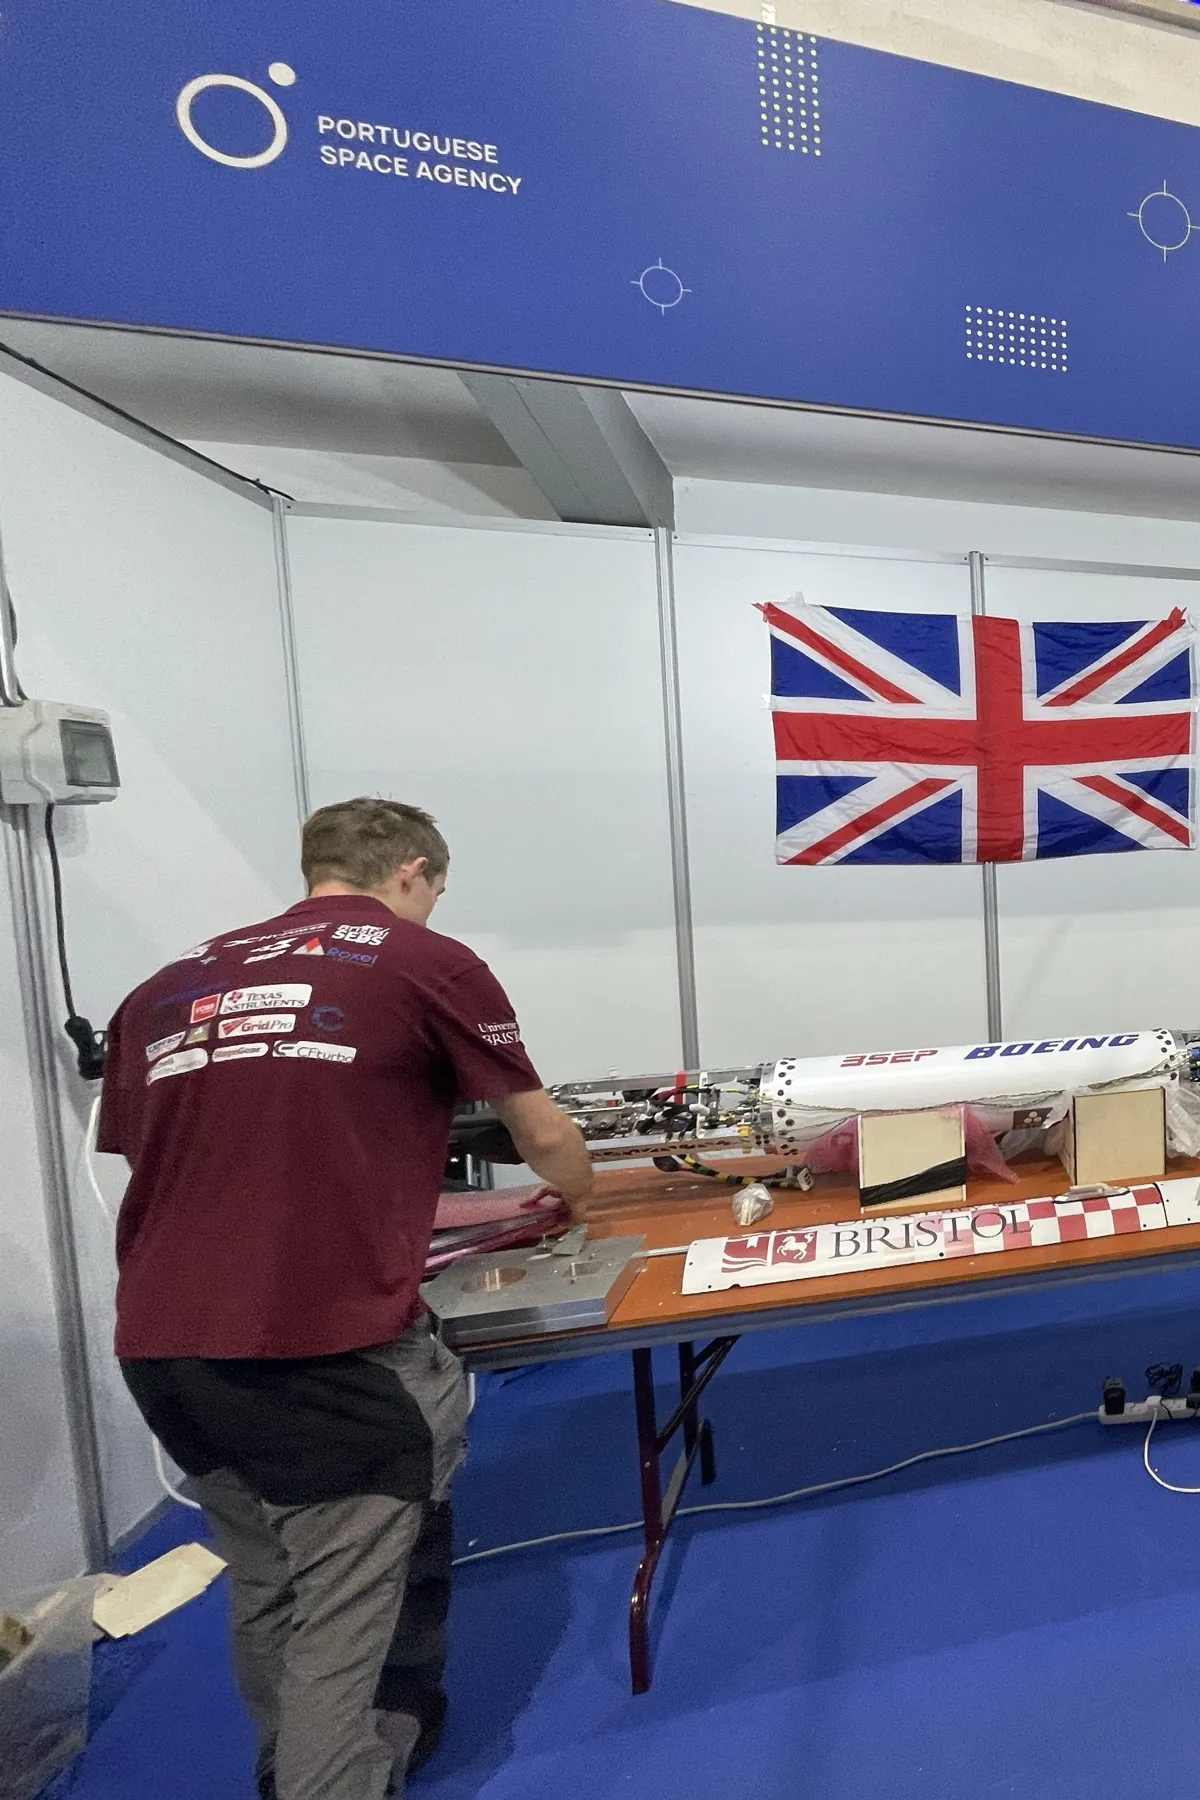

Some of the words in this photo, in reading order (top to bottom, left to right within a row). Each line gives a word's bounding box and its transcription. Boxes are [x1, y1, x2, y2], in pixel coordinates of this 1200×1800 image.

[317, 115, 499, 164] PORTUGUESE
[320, 145, 409, 177] SPACE
[416, 161, 522, 195] AGENCY
[223, 999, 306, 1013] INSTRUMENTS
[246, 991, 283, 1001] TEXAS
[296, 1045, 355, 1063] CFturbo
[963, 1033, 1140, 1060] BOEING
[827, 1207, 1035, 1260] BRISTOL
